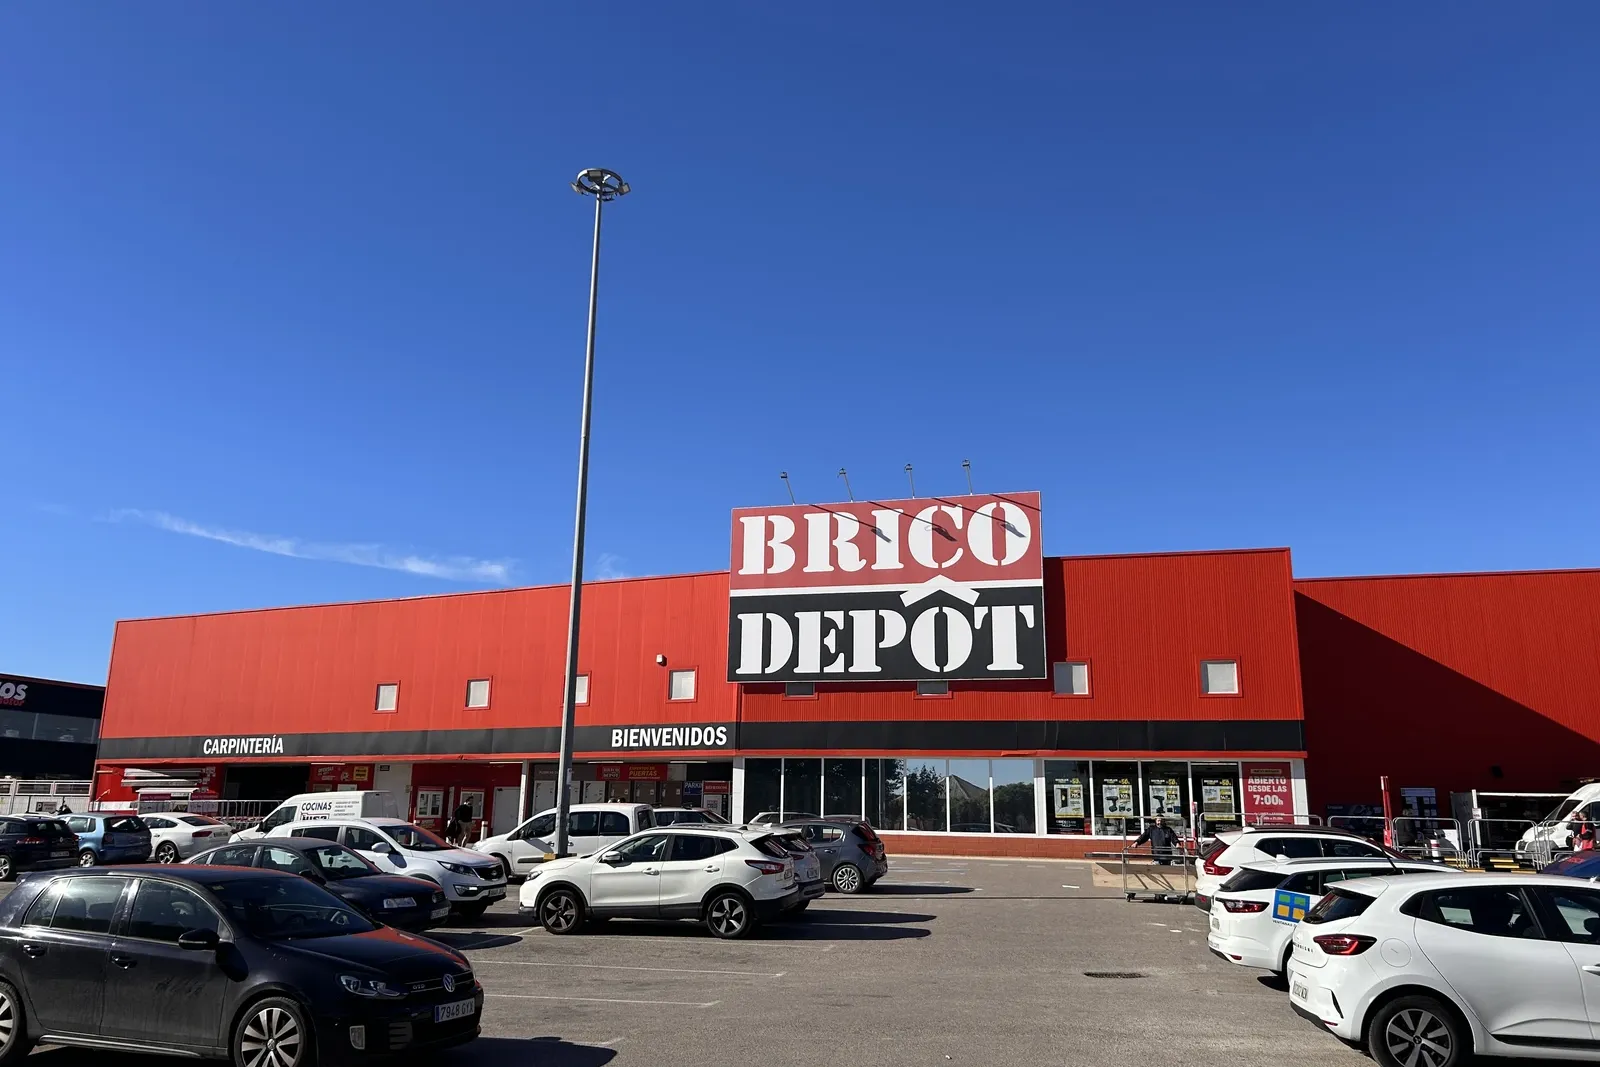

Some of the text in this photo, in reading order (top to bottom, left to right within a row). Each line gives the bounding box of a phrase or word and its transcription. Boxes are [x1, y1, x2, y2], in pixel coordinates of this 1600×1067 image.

[738, 501, 1032, 576] BRICO
[0, 682, 28, 701] OS
[203, 735, 284, 755] CARPINTERÍA
[611, 727, 727, 747] BIENVENIDOS
[1247, 785, 1288, 793] DESDE LAS
[1248, 776, 1287, 785] ABIERTO
[301, 802, 332, 811] COCINAS
[1252, 794, 1284, 806] 7:00h
[440, 1000, 474, 1021] 7948 GYX
